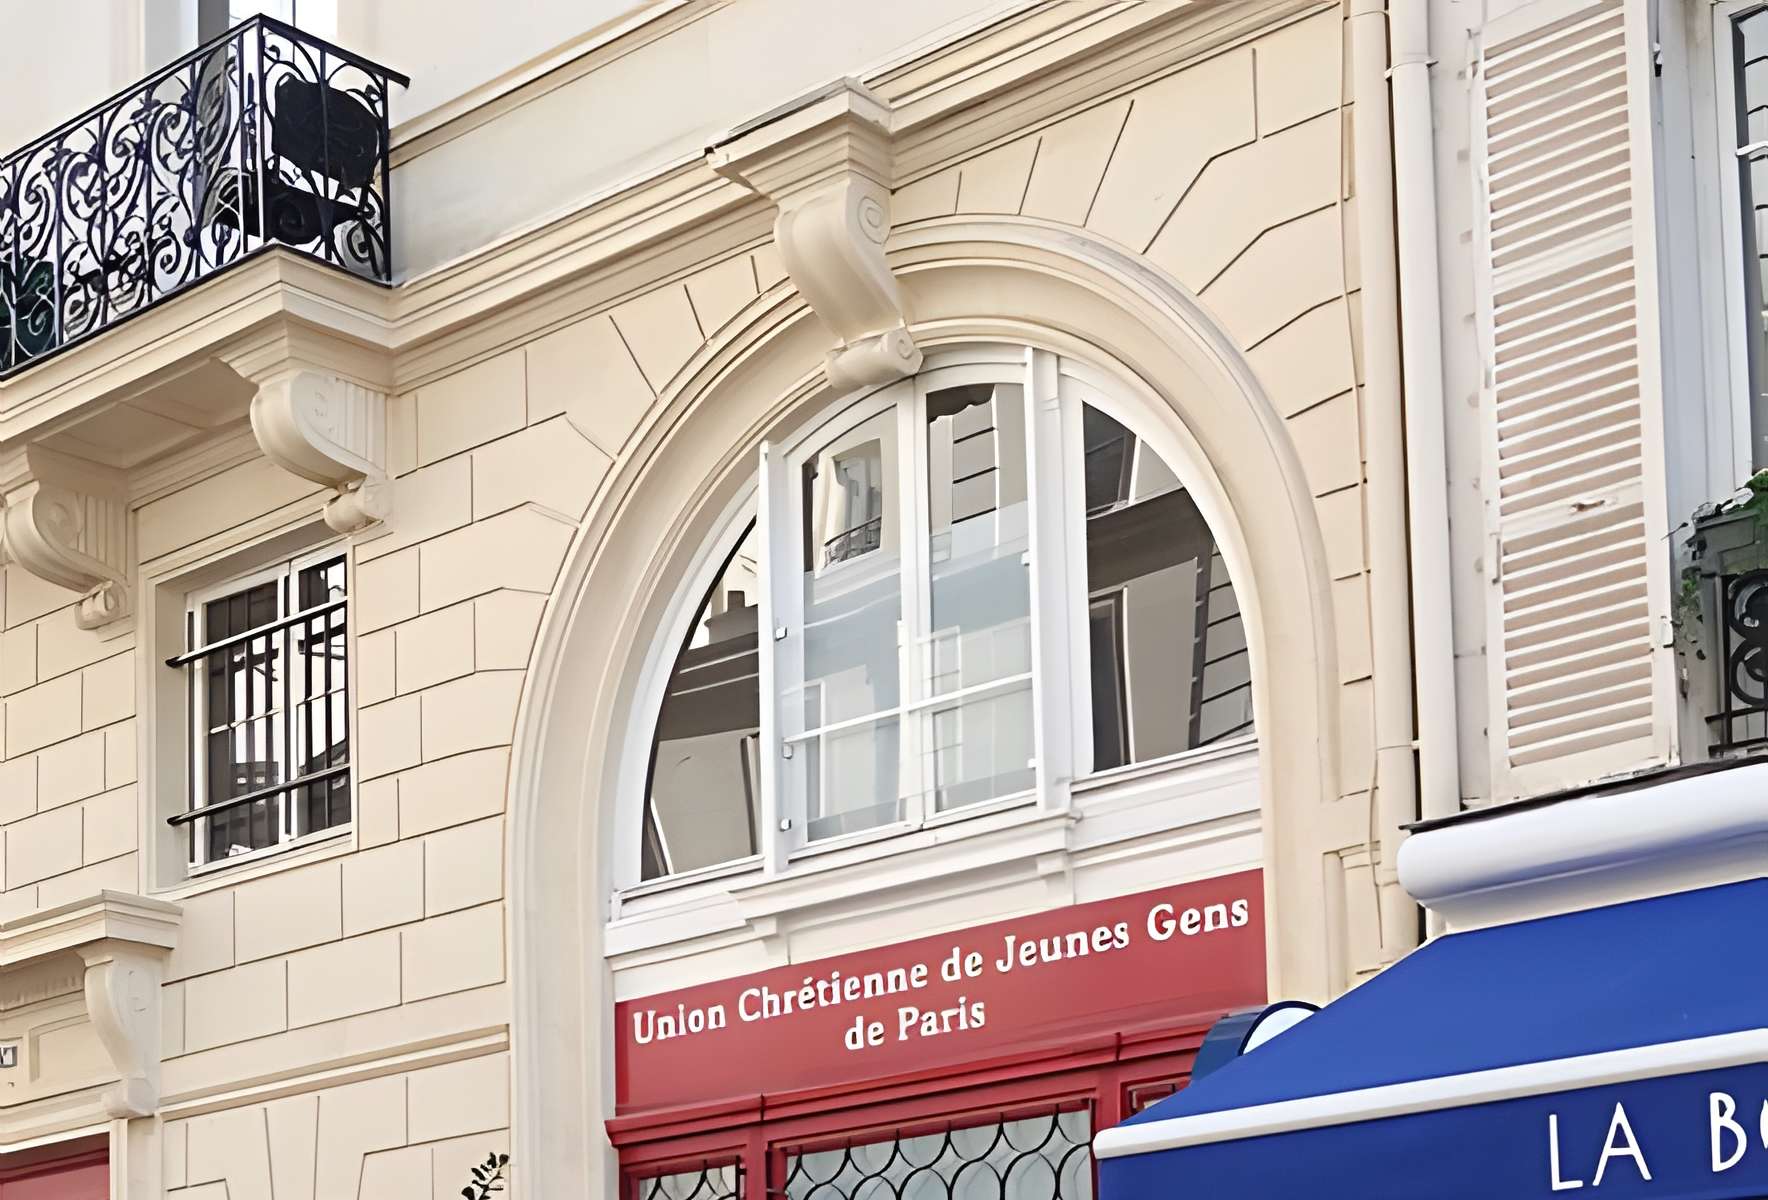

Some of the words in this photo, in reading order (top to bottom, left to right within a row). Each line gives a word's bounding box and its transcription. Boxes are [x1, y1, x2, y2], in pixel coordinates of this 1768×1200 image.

[632, 1002, 727, 1045] Union
[738, 963, 929, 1023] Chrétienne
[940, 946, 984, 983] de
[995, 921, 1131, 973] Jeunes
[1147, 898, 1250, 941] Gens
[844, 1014, 885, 1051] de
[897, 996, 987, 1042] Paris
[1548, 1100, 1653, 1192] LA
[1708, 1090, 1768, 1173] B
